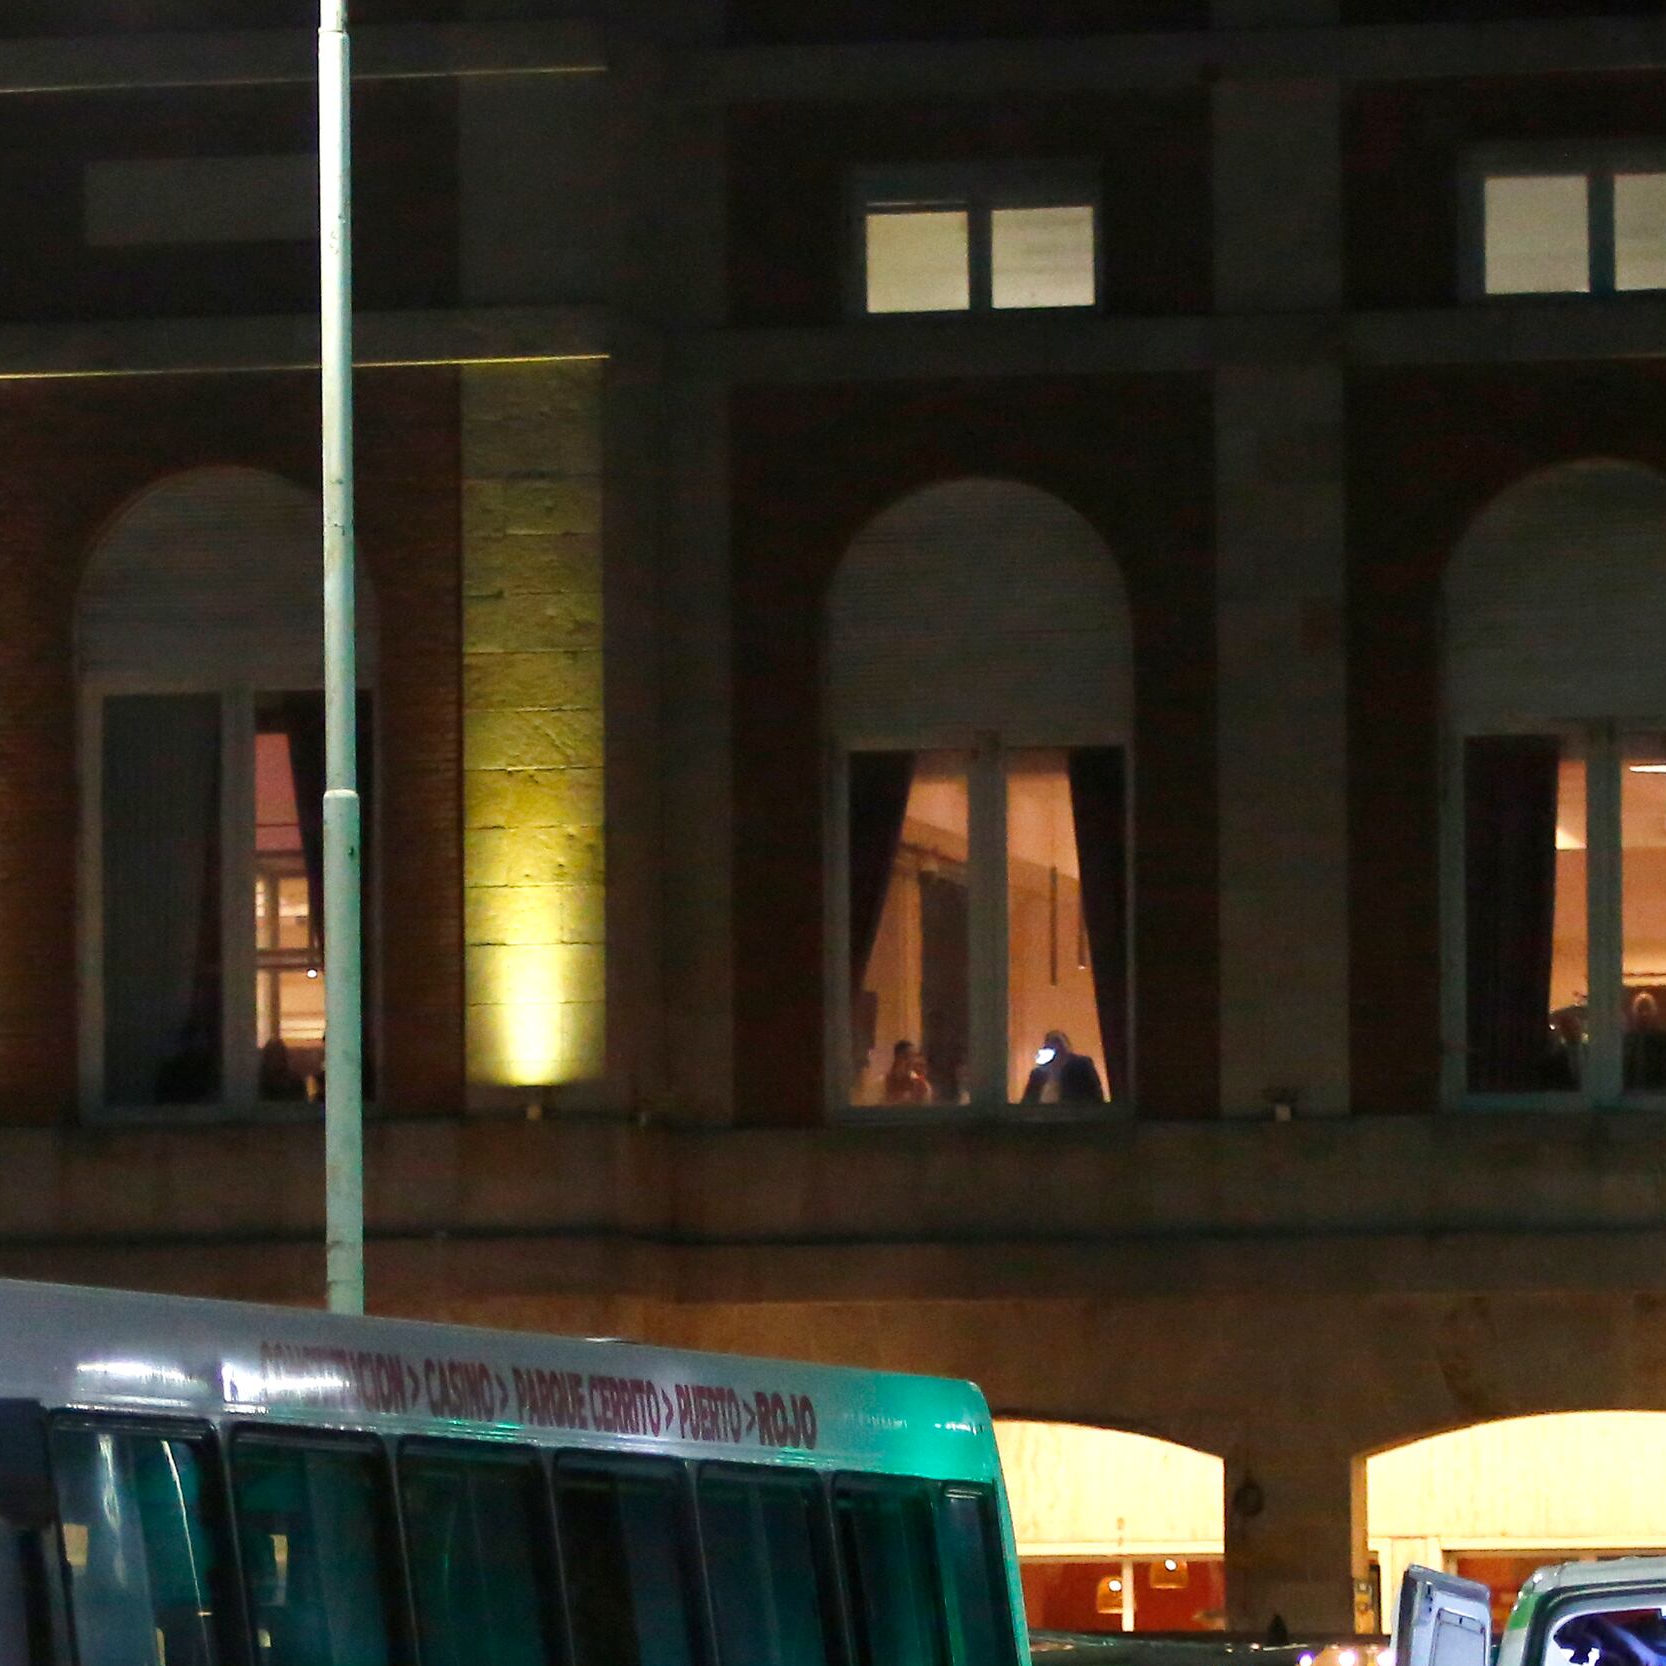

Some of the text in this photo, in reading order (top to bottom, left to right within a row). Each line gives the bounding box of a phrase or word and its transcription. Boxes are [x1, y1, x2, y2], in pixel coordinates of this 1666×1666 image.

[423, 1357, 495, 1422] CASINO
[511, 1366, 588, 1431] PARQUE
[587, 1374, 662, 1438] CERRITO
[674, 1383, 743, 1444] PUERTO
[754, 1390, 818, 1451] ROJO
